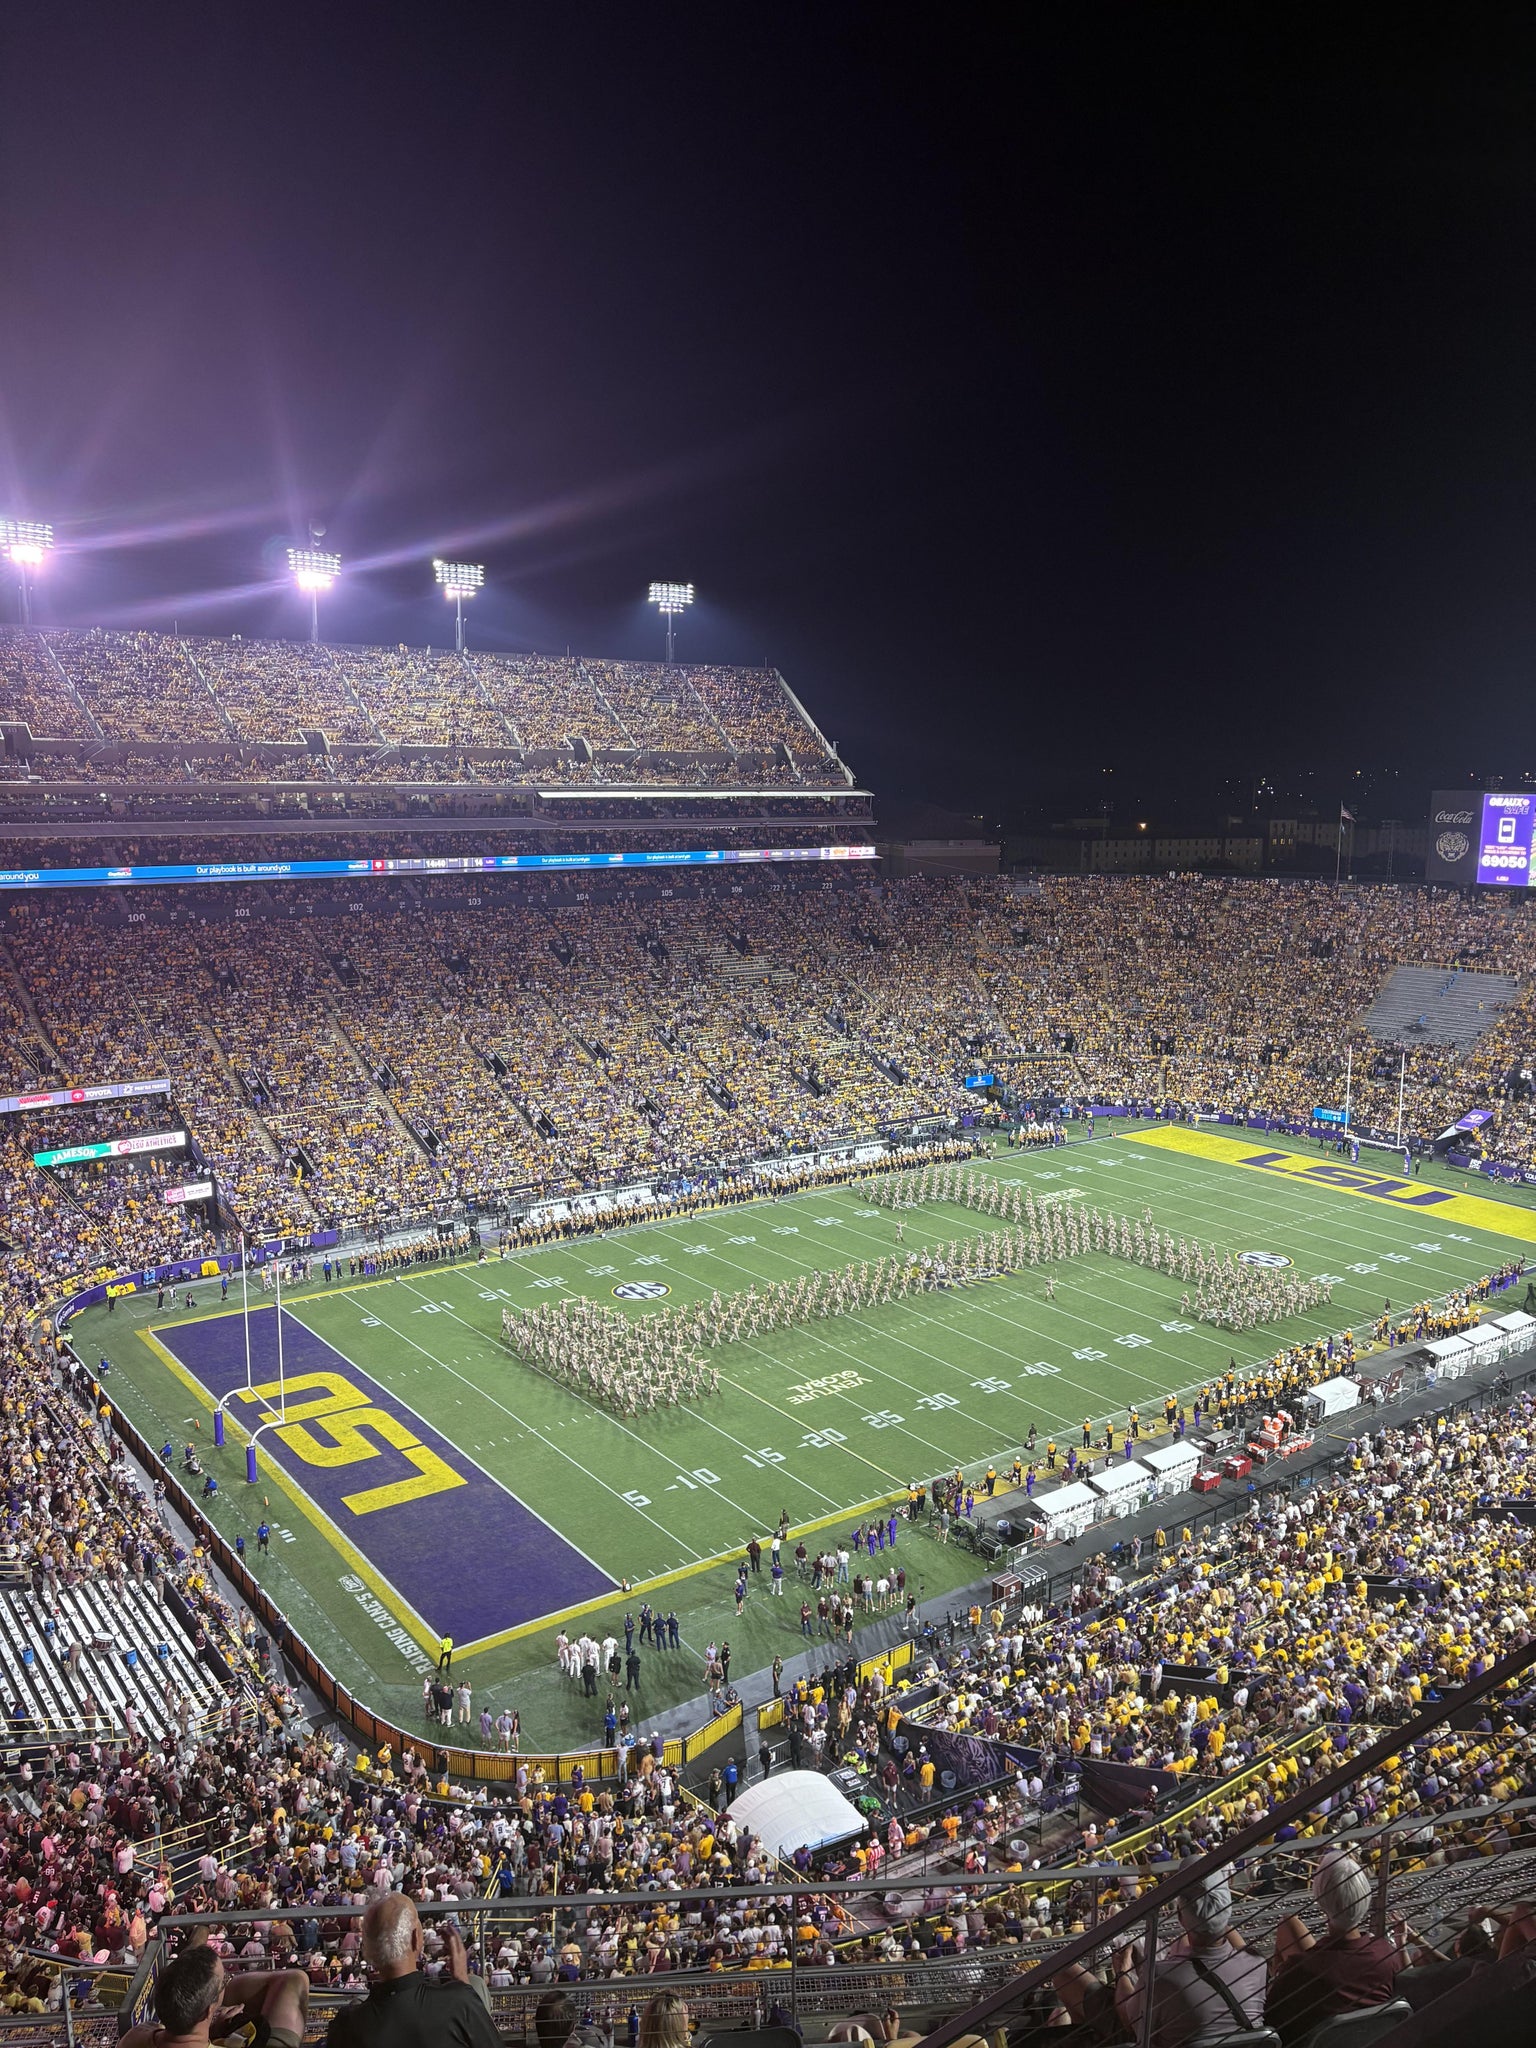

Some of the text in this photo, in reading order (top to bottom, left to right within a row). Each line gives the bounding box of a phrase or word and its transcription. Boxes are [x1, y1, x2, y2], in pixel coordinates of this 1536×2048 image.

[1504, 806, 1530, 815] SAFE
[1481, 854, 1528, 869] 69050
[209, 865, 237, 875] playbook
[257, 864, 278, 872] around
[277, 864, 291, 873] you
[23, 872, 39, 882] you
[576, 893, 589, 901] 104
[661, 889, 673, 897] 105
[349, 903, 364, 911] 102
[468, 898, 482, 906] 103
[127, 913, 146, 923] 100
[234, 908, 251, 917] 101
[85, 1088, 113, 1097] TOYOTA
[132, 1140, 144, 1150] LSU
[145, 1136, 177, 1147] ATHLETICS
[51, 1148, 98, 1165] JAMESON
[1236, 1152, 1459, 1206] LSU
[1447, 1233, 1472, 1243] 5
[636, 1254, 669, 1266] 30
[1379, 1252, 1412, 1263] 15
[585, 1264, 620, 1277] 25
[532, 1276, 568, 1289] 20
[478, 1288, 512, 1301] 15
[615, 1281, 670, 1299] SEC
[420, 1301, 455, 1314] 10
[361, 1317, 382, 1328] 5
[1160, 1320, 1195, 1334] 45
[1113, 1333, 1153, 1348] 50
[1072, 1347, 1108, 1362] 45
[1023, 1361, 1062, 1377] 40
[787, 1370, 859, 1393] GLOBAL
[970, 1376, 1012, 1394] 35
[786, 1376, 874, 1405] VENTURE
[917, 1392, 960, 1411] 30
[861, 1409, 906, 1429] 25
[236, 1371, 469, 1516] LSU
[801, 1427, 849, 1448] 20
[742, 1447, 787, 1468] 15
[676, 1467, 722, 1490] 10
[621, 1489, 652, 1507] 5
[354, 1592, 436, 1675] RAISING CANE'S
